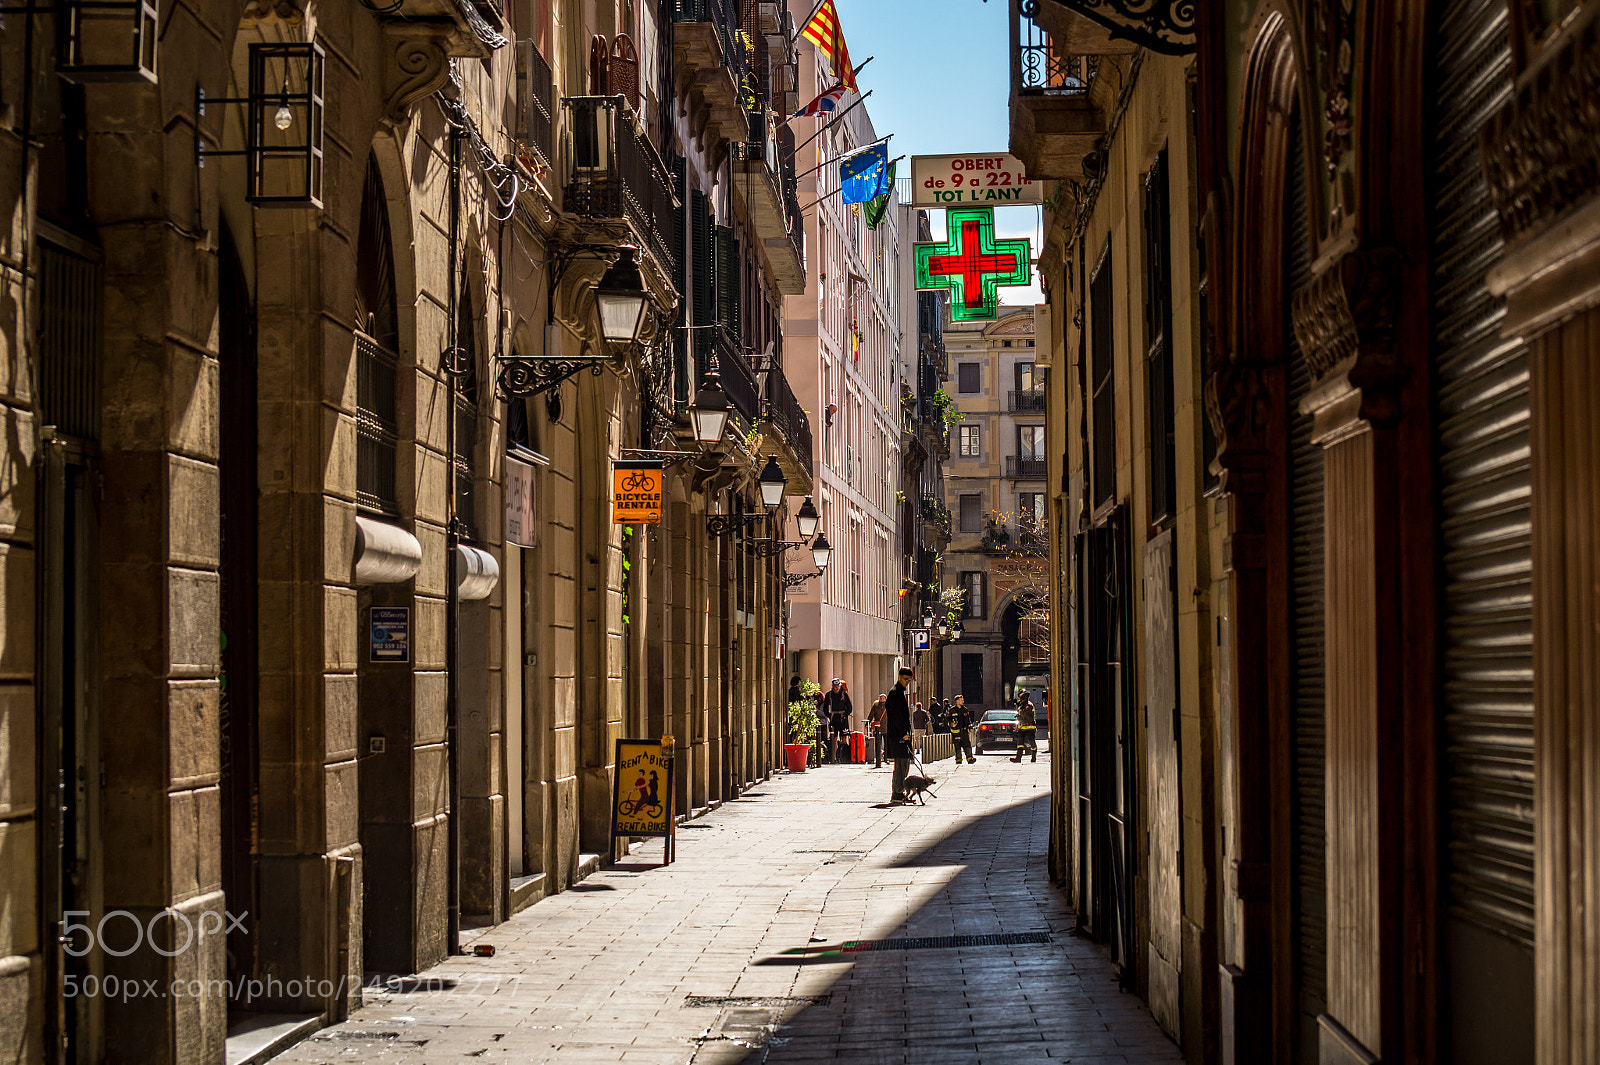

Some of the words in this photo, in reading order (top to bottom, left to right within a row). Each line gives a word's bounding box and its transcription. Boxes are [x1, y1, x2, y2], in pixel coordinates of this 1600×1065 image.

[951, 158, 1003, 171] OBERT
[924, 176, 945, 188] de
[951, 173, 964, 188] 9
[969, 178, 980, 187] a
[985, 172, 1012, 186] 22
[1017, 173, 1032, 185] h.
[933, 190, 964, 203] TOT
[971, 187, 1023, 201] L'ANY
[615, 493, 660, 501] BICYCLE
[617, 501, 659, 509] RENTAL
[915, 631, 928, 648] P
[620, 754, 642, 769] RENT
[643, 751, 649, 760] A
[649, 754, 669, 769] BIKE
[617, 822, 641, 831] RENT
[641, 822, 647, 831] A
[647, 821, 666, 831] BIKE
